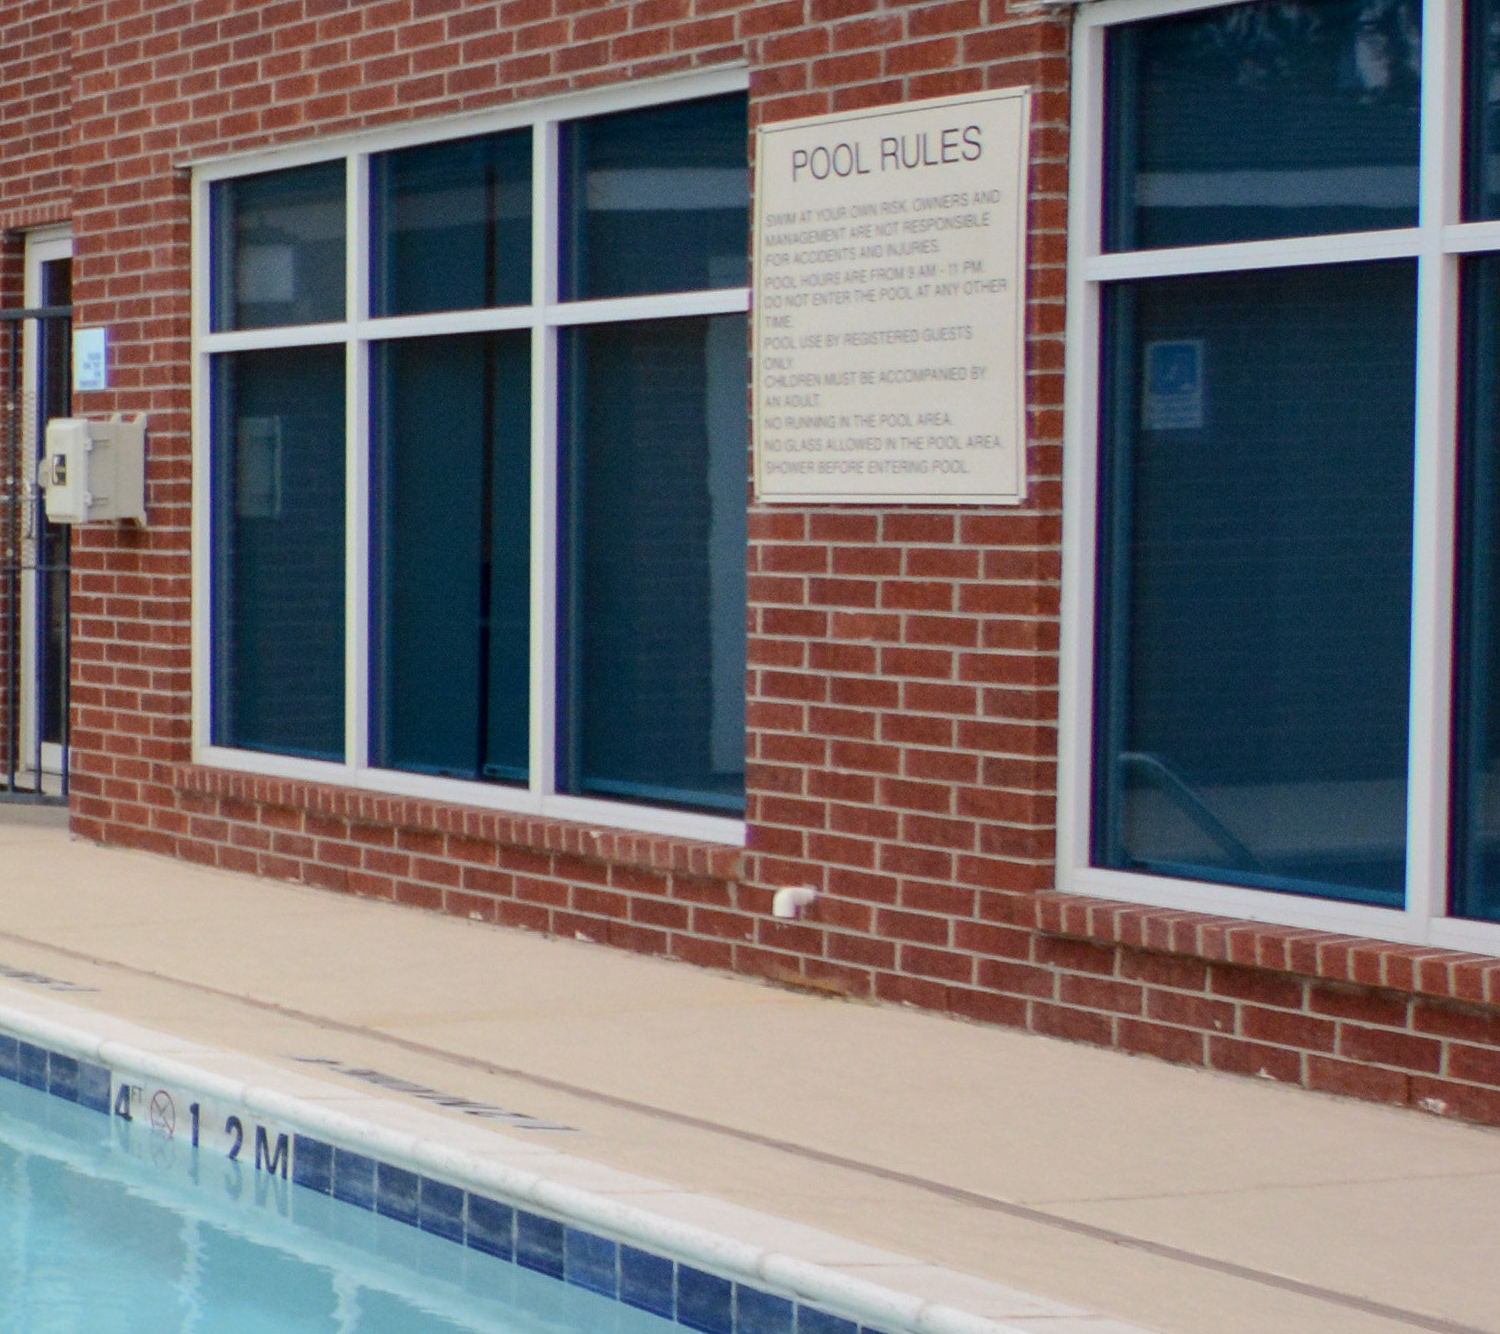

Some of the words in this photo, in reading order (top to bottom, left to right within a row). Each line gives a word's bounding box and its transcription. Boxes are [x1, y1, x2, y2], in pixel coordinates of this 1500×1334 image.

[791, 142, 871, 182] POOL
[880, 125, 983, 172] RULES
[765, 213, 797, 228] SWIM
[800, 209, 813, 223] AT
[816, 206, 847, 223] YOUR
[850, 203, 878, 219] OWN
[912, 193, 969, 212] OWNERS
[972, 188, 1001, 206] AND
[765, 228, 846, 247] MANAGEMENT
[849, 224, 873, 240] ARE
[875, 221, 900, 237] NOT
[903, 211, 991, 234] RESPONSIBLE
[765, 252, 791, 267] FOR
[793, 247, 857, 266] ACCIDENTS
[859, 244, 883, 259] AND
[765, 276, 798, 290] POOL
[800, 271, 841, 287] HOURS
[844, 269, 868, 284] ARE
[869, 266, 905, 281] FROM
[764, 295, 783, 309] DO
[785, 293, 809, 308] NOT
[811, 290, 851, 306] ENTER
[854, 288, 877, 303] THE
[880, 285, 914, 302] POOL
[917, 283, 932, 297] AT
[935, 282, 961, 297] ANY
[963, 277, 1008, 296] OTHER
[764, 336, 798, 350] POOL
[800, 334, 822, 349] USE
[825, 333, 841, 348] BY
[843, 328, 920, 346] REGISTERED
[921, 324, 973, 343] GUESTS
[764, 373, 822, 389] CHILDREN
[824, 371, 857, 387] MUST
[860, 370, 877, 385] BE
[879, 367, 968, 384] ACCOMPANIED
[970, 365, 988, 381] BY
[765, 395, 782, 408] AN
[764, 415, 782, 430] NO
[784, 415, 837, 430] RUNNING
[839, 414, 851, 428] IN
[853, 414, 877, 429] THE
[879, 413, 914, 428] POOL
[764, 438, 782, 453] NO
[785, 437, 823, 453] GLASS
[825, 437, 883, 453] ALLOWED
[885, 436, 898, 451] IN
[900, 436, 926, 451] THE
[927, 434, 962, 451] POOL
[765, 459, 816, 475] SHOWER
[817, 459, 865, 475] BEFORE
[867, 459, 930, 475] ENTERING
[114, 1082, 133, 1122] 4
[132, 1084, 143, 1104] FT
